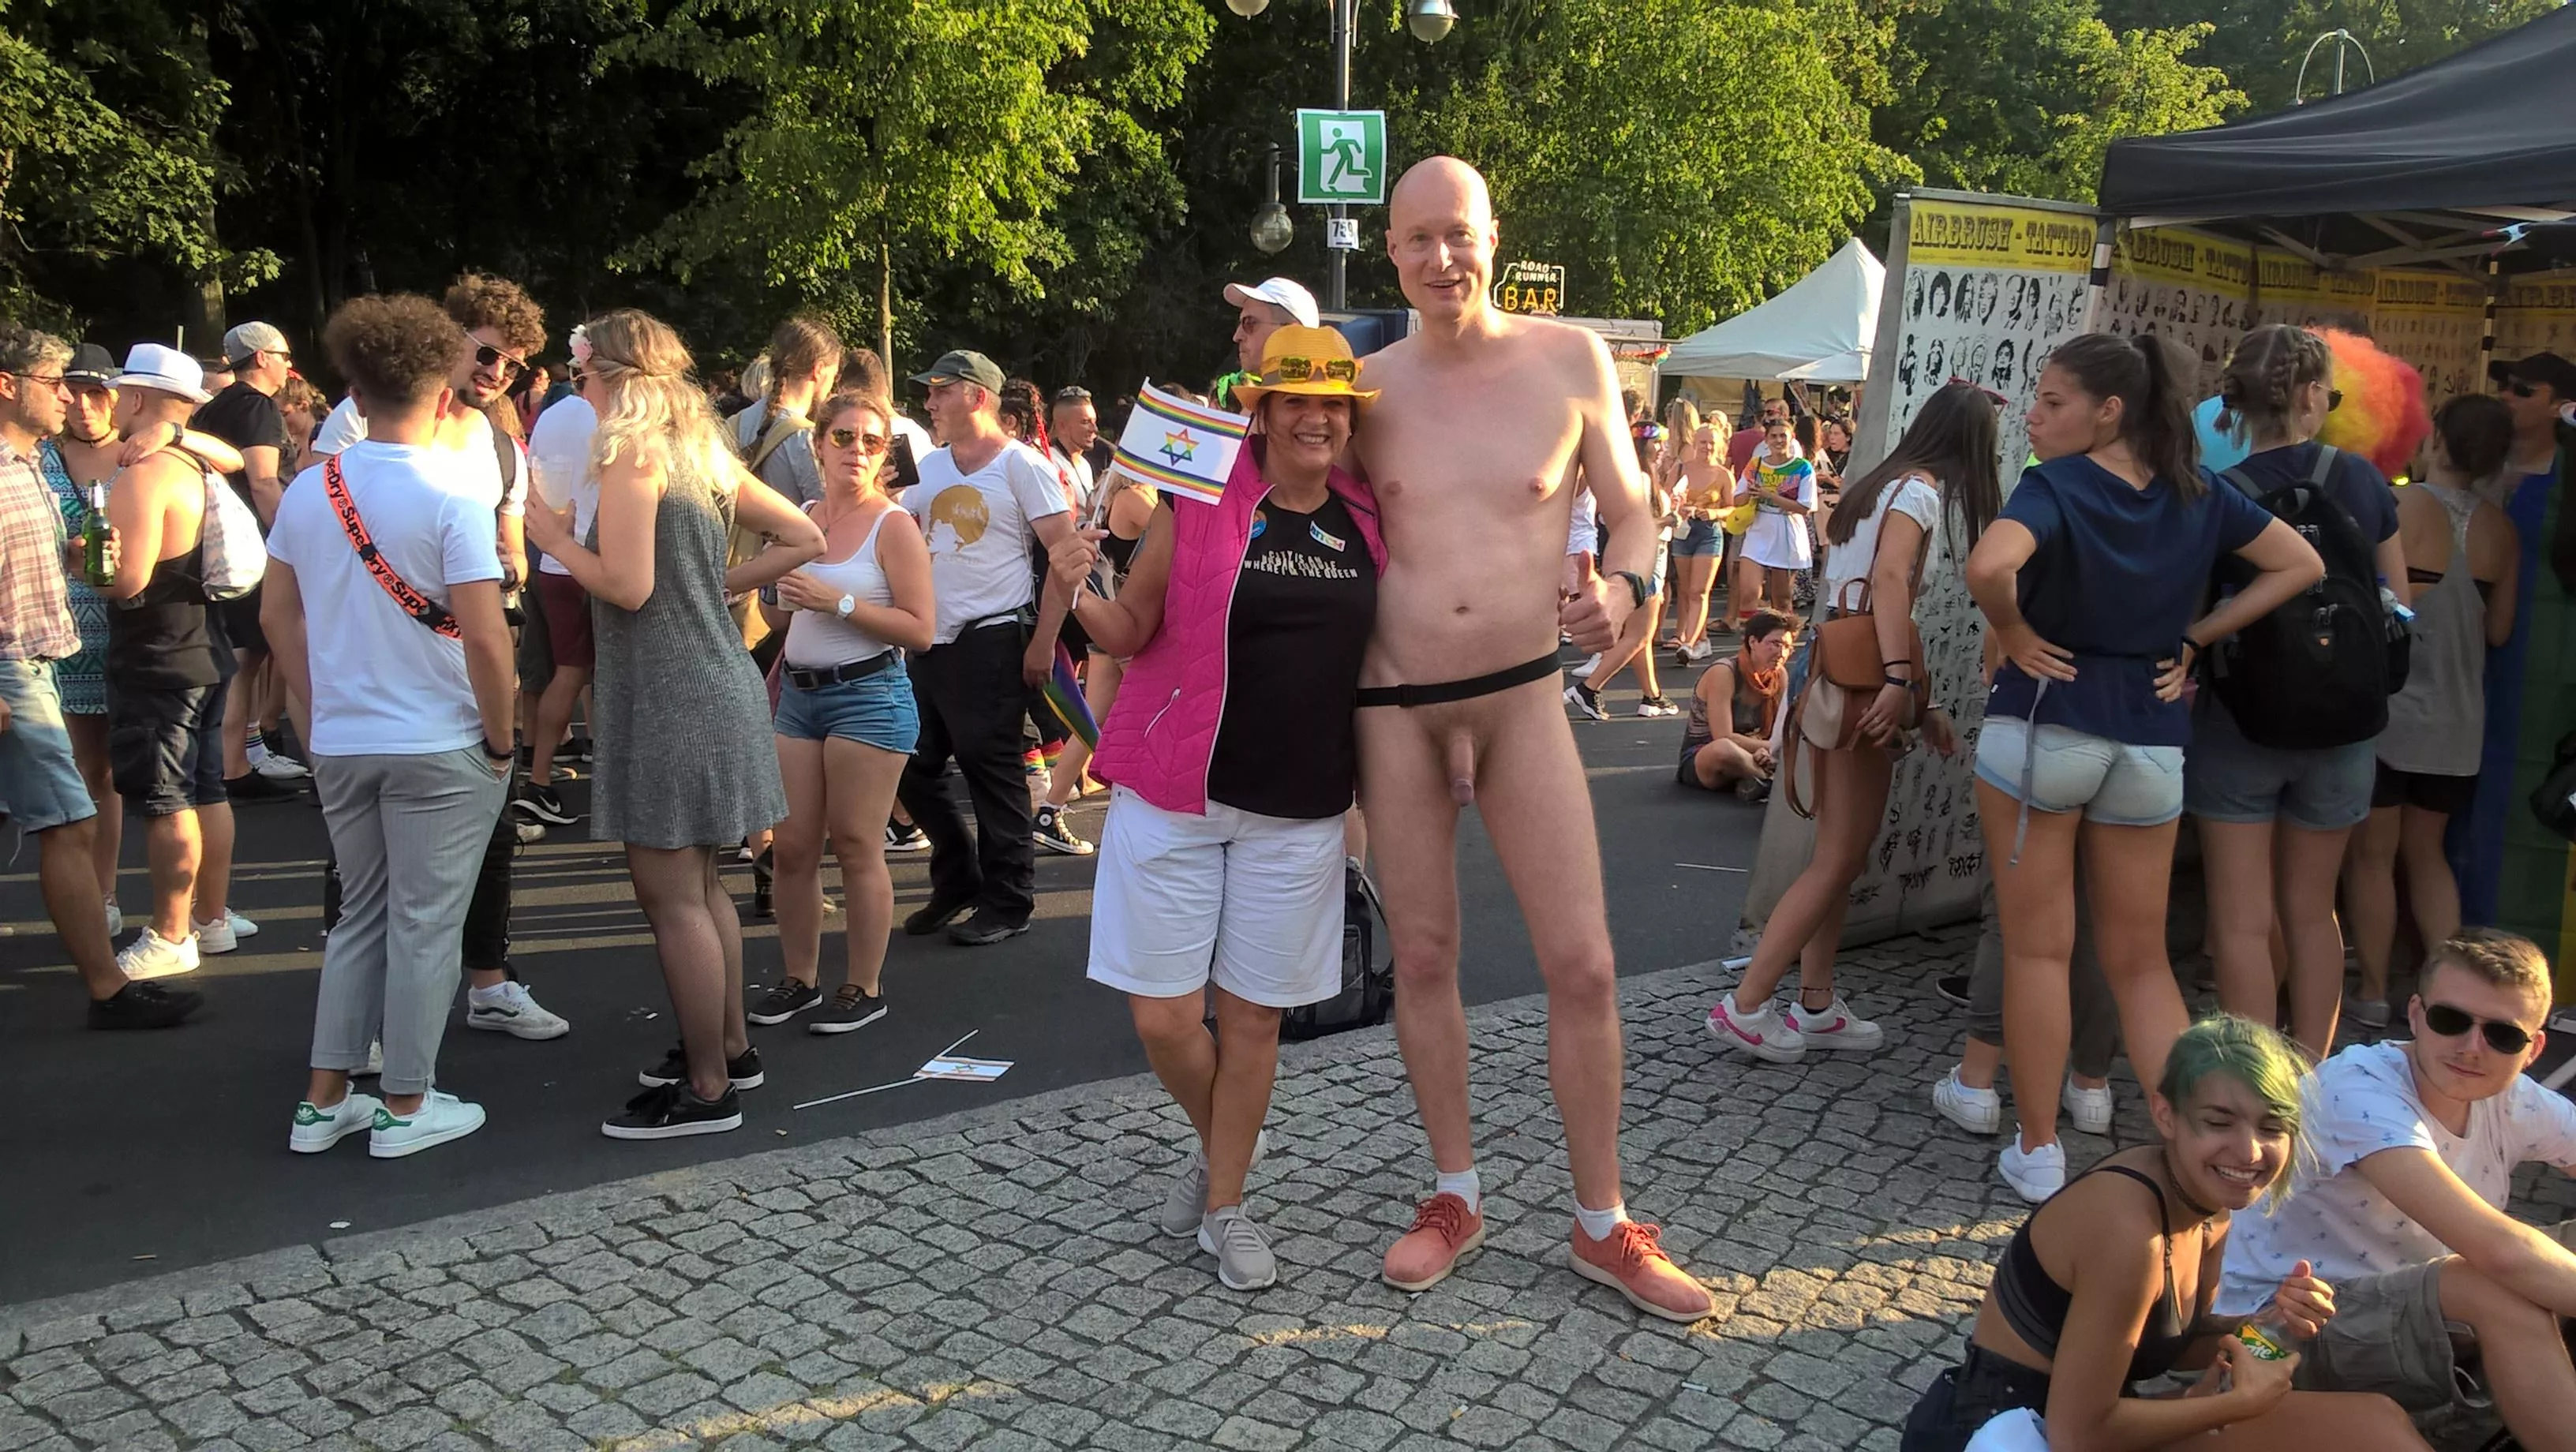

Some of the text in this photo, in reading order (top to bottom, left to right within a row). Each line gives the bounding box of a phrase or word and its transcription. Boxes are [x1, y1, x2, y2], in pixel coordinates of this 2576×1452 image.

[1911, 212, 2013, 252] AIRBRUSH
[2026, 221, 2091, 258] TATTOO
[1521, 260, 1550, 273] ROAD
[1515, 271, 1557, 283] RUNNER
[1505, 286, 1558, 312] BAR
[1244, 559, 1281, 574] WHERE
[1324, 568, 1358, 579] QUEEN
